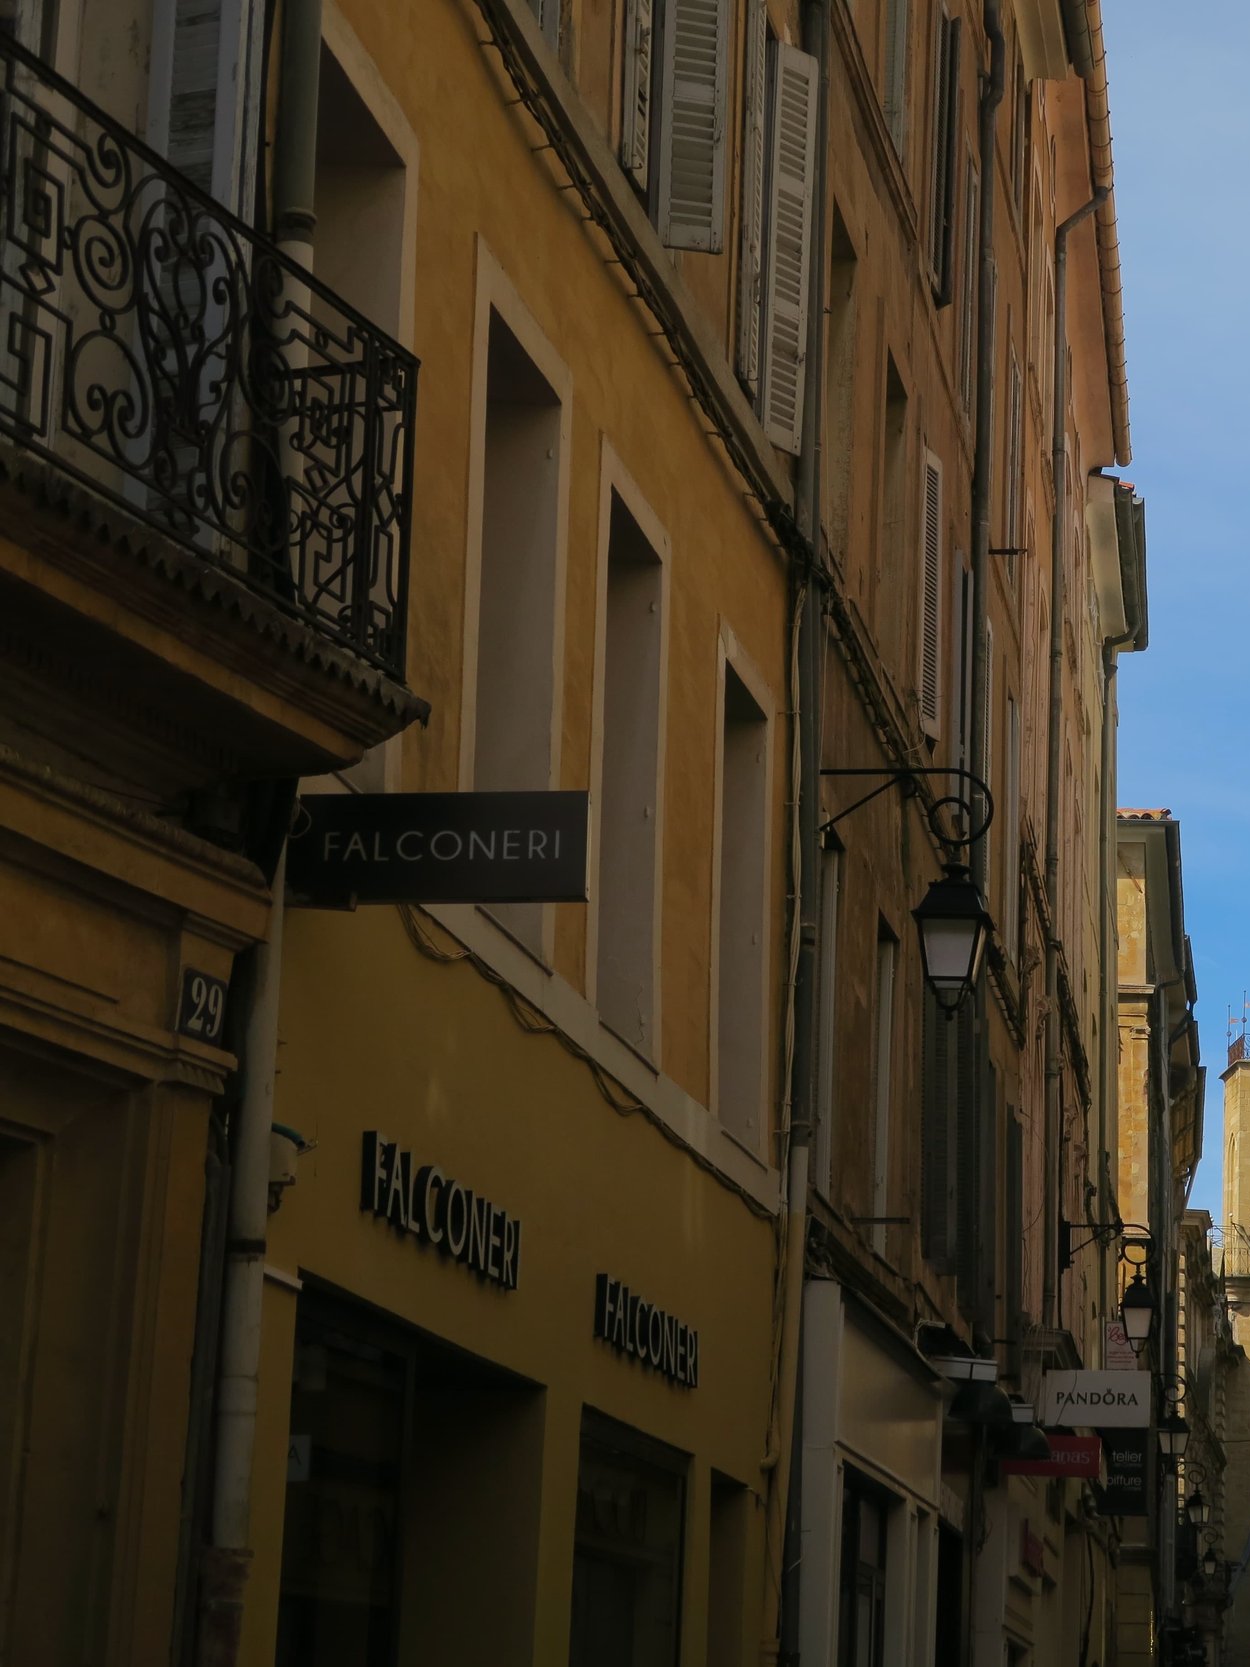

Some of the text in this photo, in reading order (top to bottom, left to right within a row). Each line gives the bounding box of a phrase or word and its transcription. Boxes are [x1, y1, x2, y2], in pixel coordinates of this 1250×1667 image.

[323, 830, 560, 862] FALCONERI
[187, 975, 223, 1039] 29
[364, 1131, 520, 1289] FALCONERI
[597, 1274, 699, 1388] FALCONERI
[1056, 1390, 1138, 1406] PANDORA
[1111, 1450, 1142, 1463] telier
[1105, 1474, 1142, 1487] oiffure
